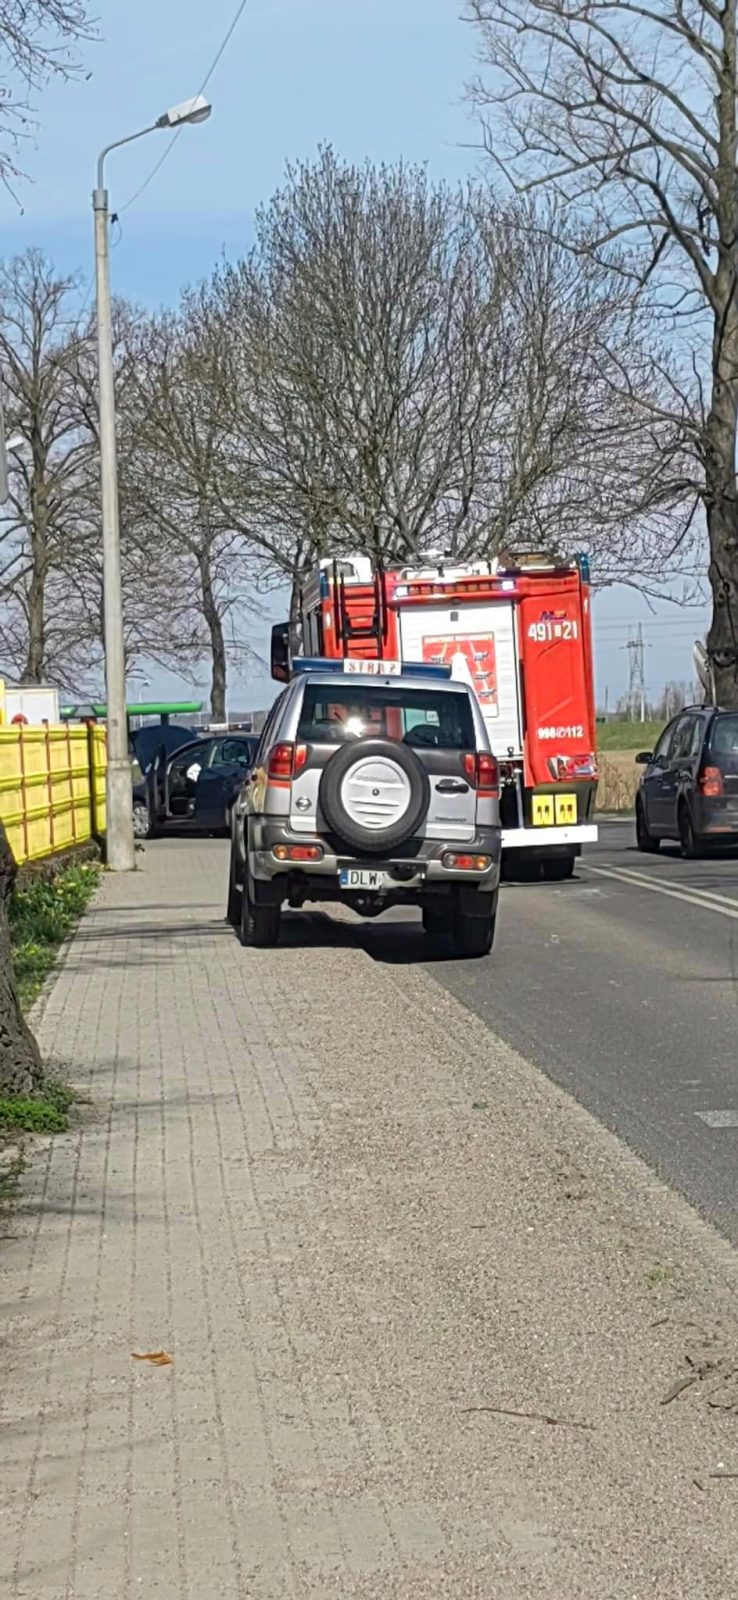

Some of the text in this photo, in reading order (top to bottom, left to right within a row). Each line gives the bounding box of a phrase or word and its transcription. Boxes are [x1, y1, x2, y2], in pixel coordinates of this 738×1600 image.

[528, 621, 552, 642] 491
[562, 620, 578, 640] 21
[566, 725, 583, 738] 112
[350, 871, 378, 886] DLW
